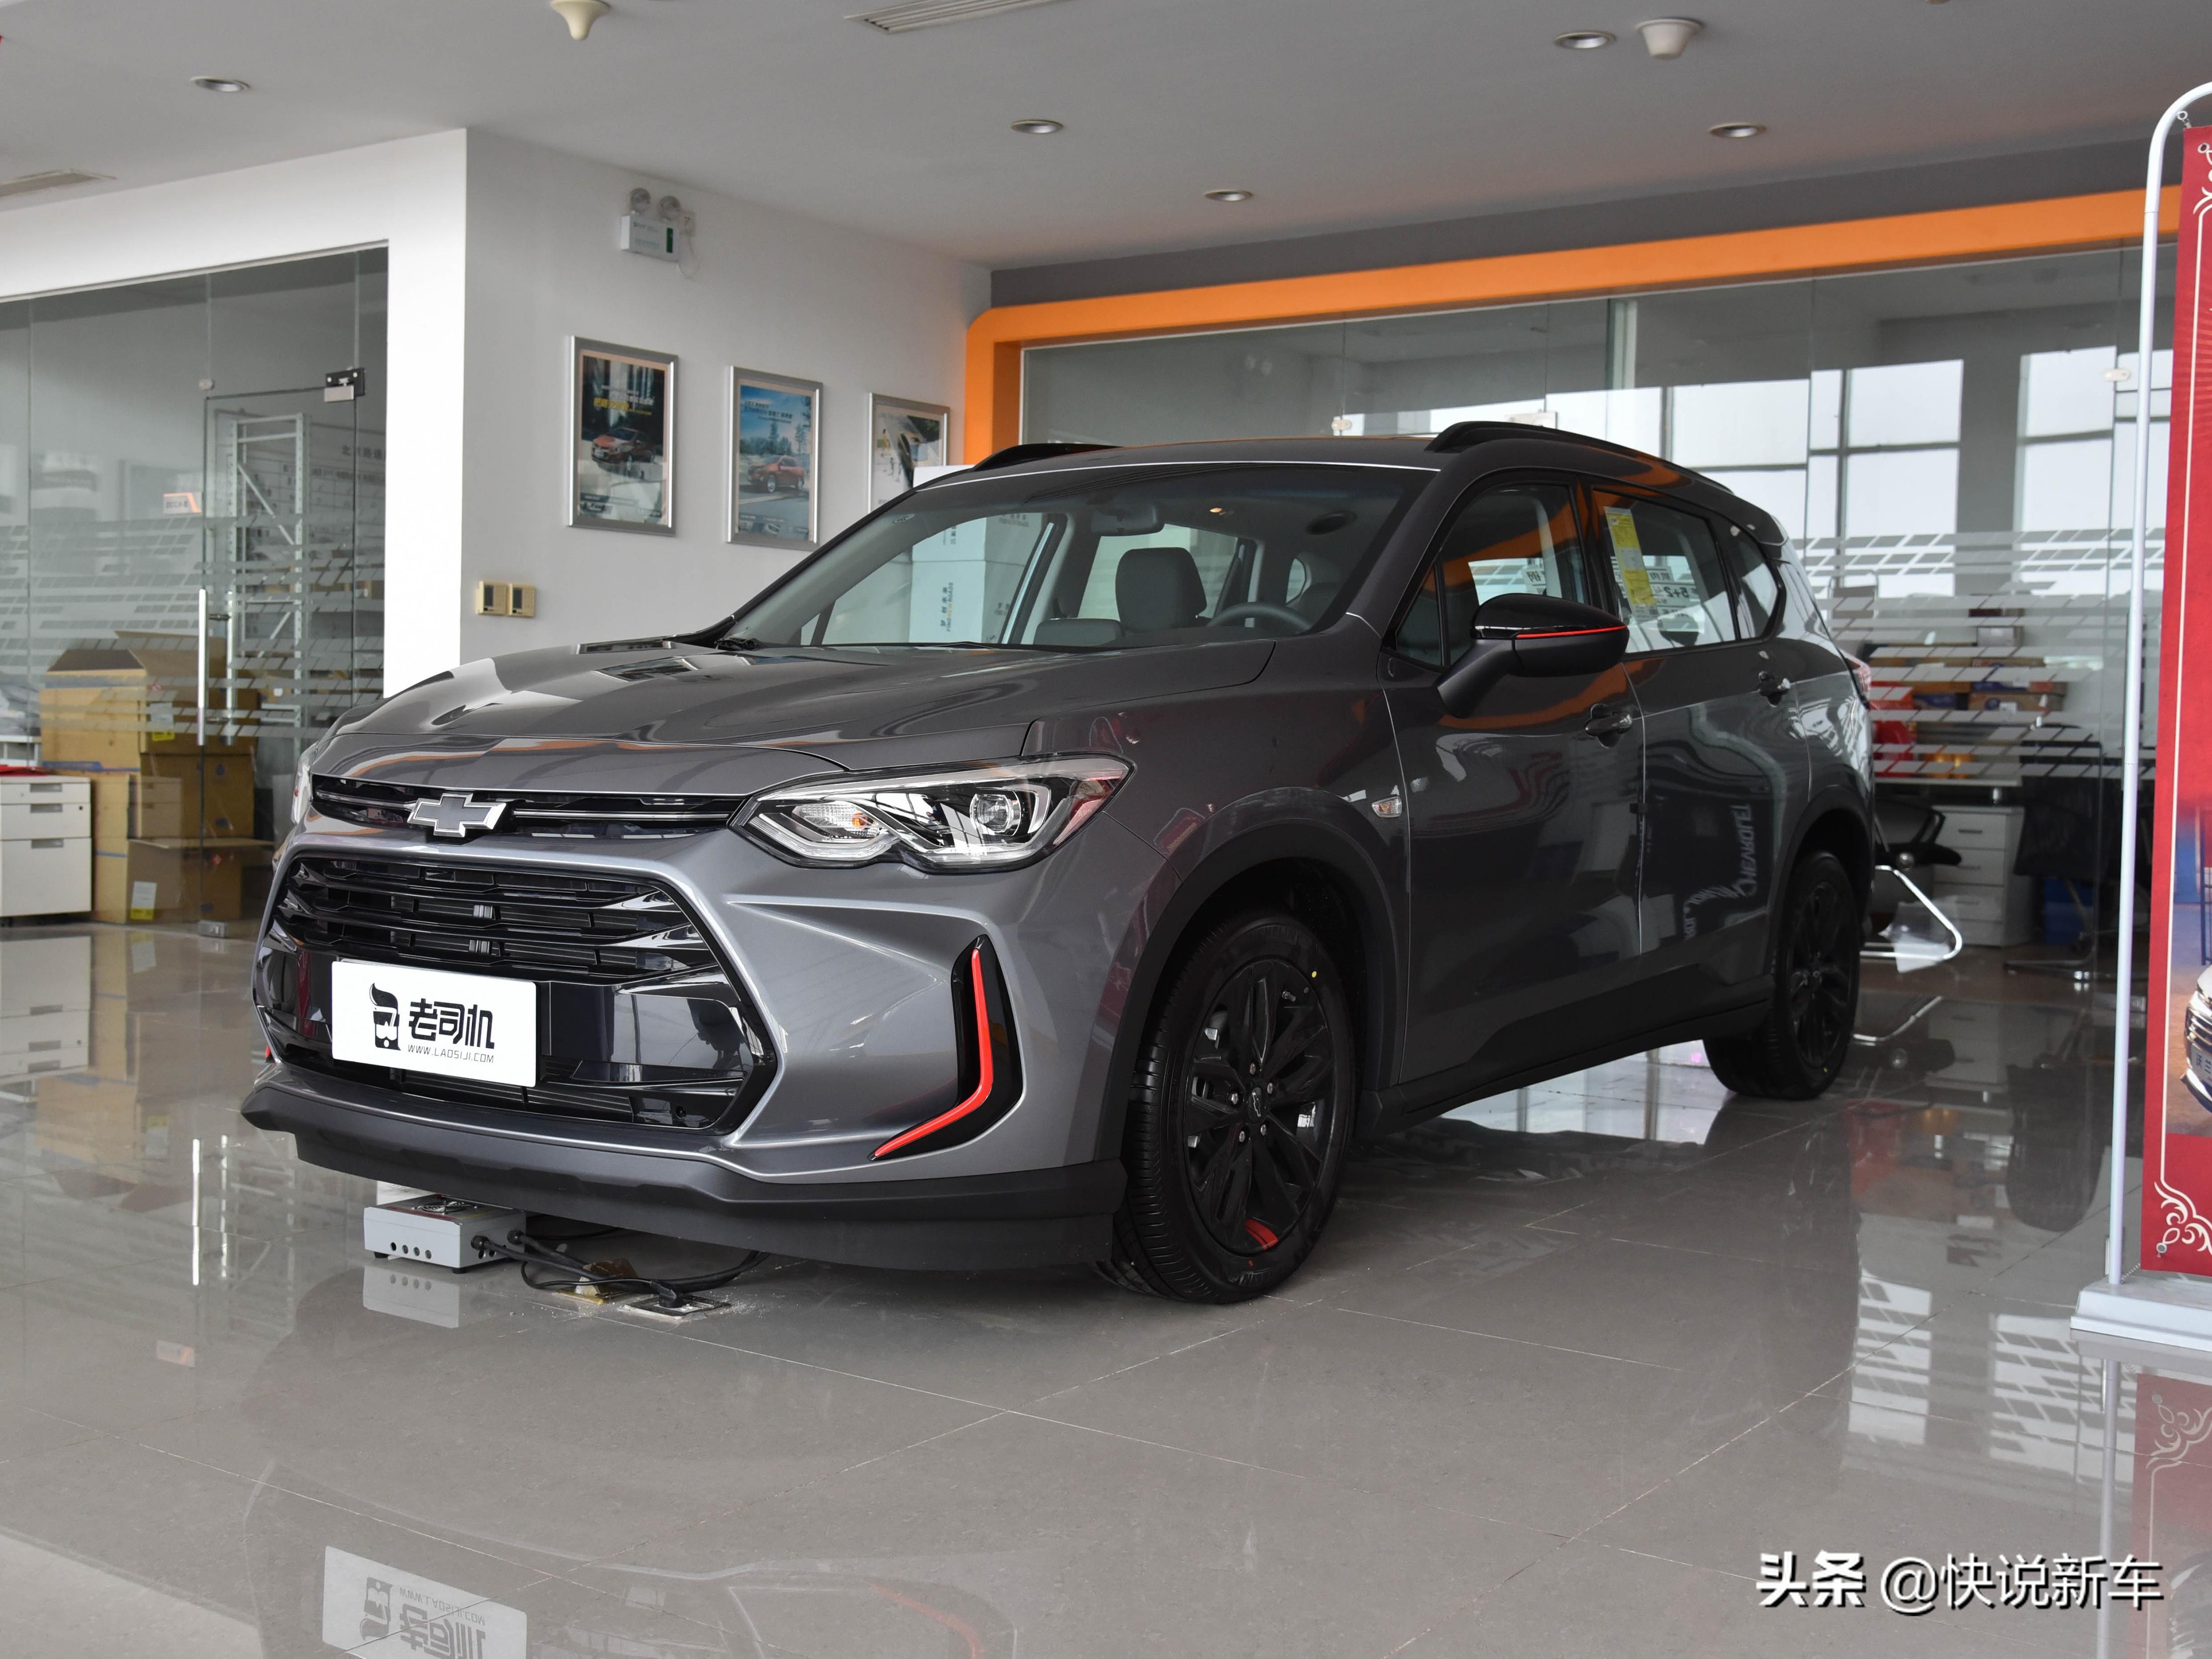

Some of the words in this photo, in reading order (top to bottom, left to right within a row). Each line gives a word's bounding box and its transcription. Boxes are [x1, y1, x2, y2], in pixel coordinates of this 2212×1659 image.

[409, 998, 495, 1049] 老司机
[408, 1044, 494, 1063] WWW.LAOSIJI.COM
